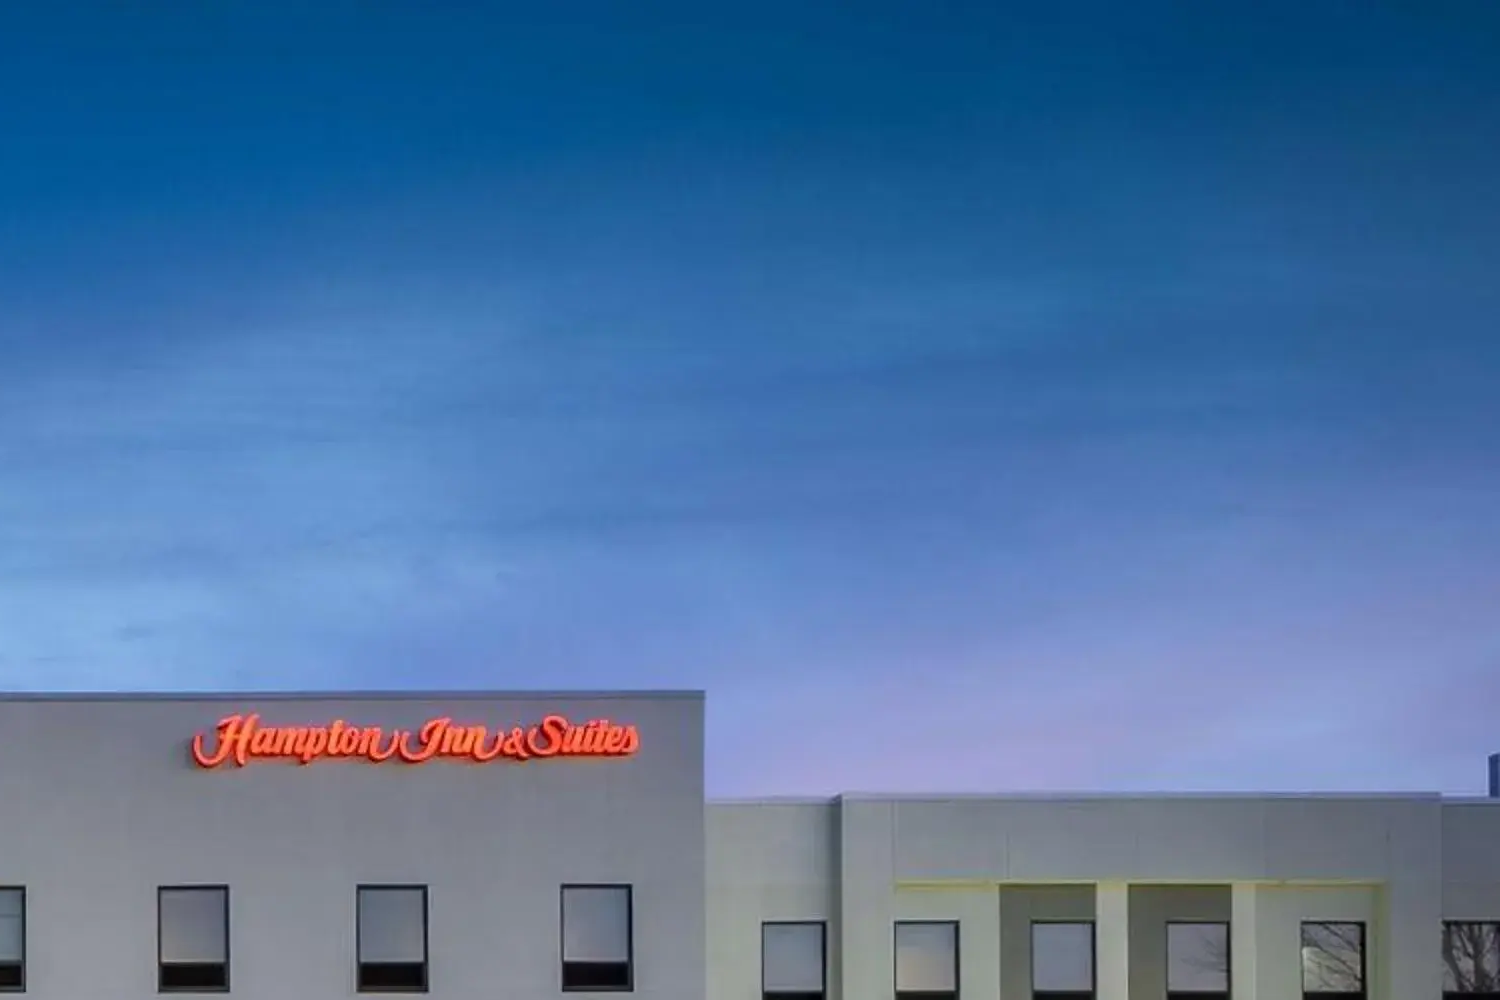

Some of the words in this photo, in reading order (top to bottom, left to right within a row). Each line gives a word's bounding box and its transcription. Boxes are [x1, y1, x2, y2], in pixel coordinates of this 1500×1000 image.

[193, 714, 399, 767] Hampton
[400, 717, 503, 761] Inn
[502, 725, 530, 759] &
[529, 715, 638, 756] Suites
